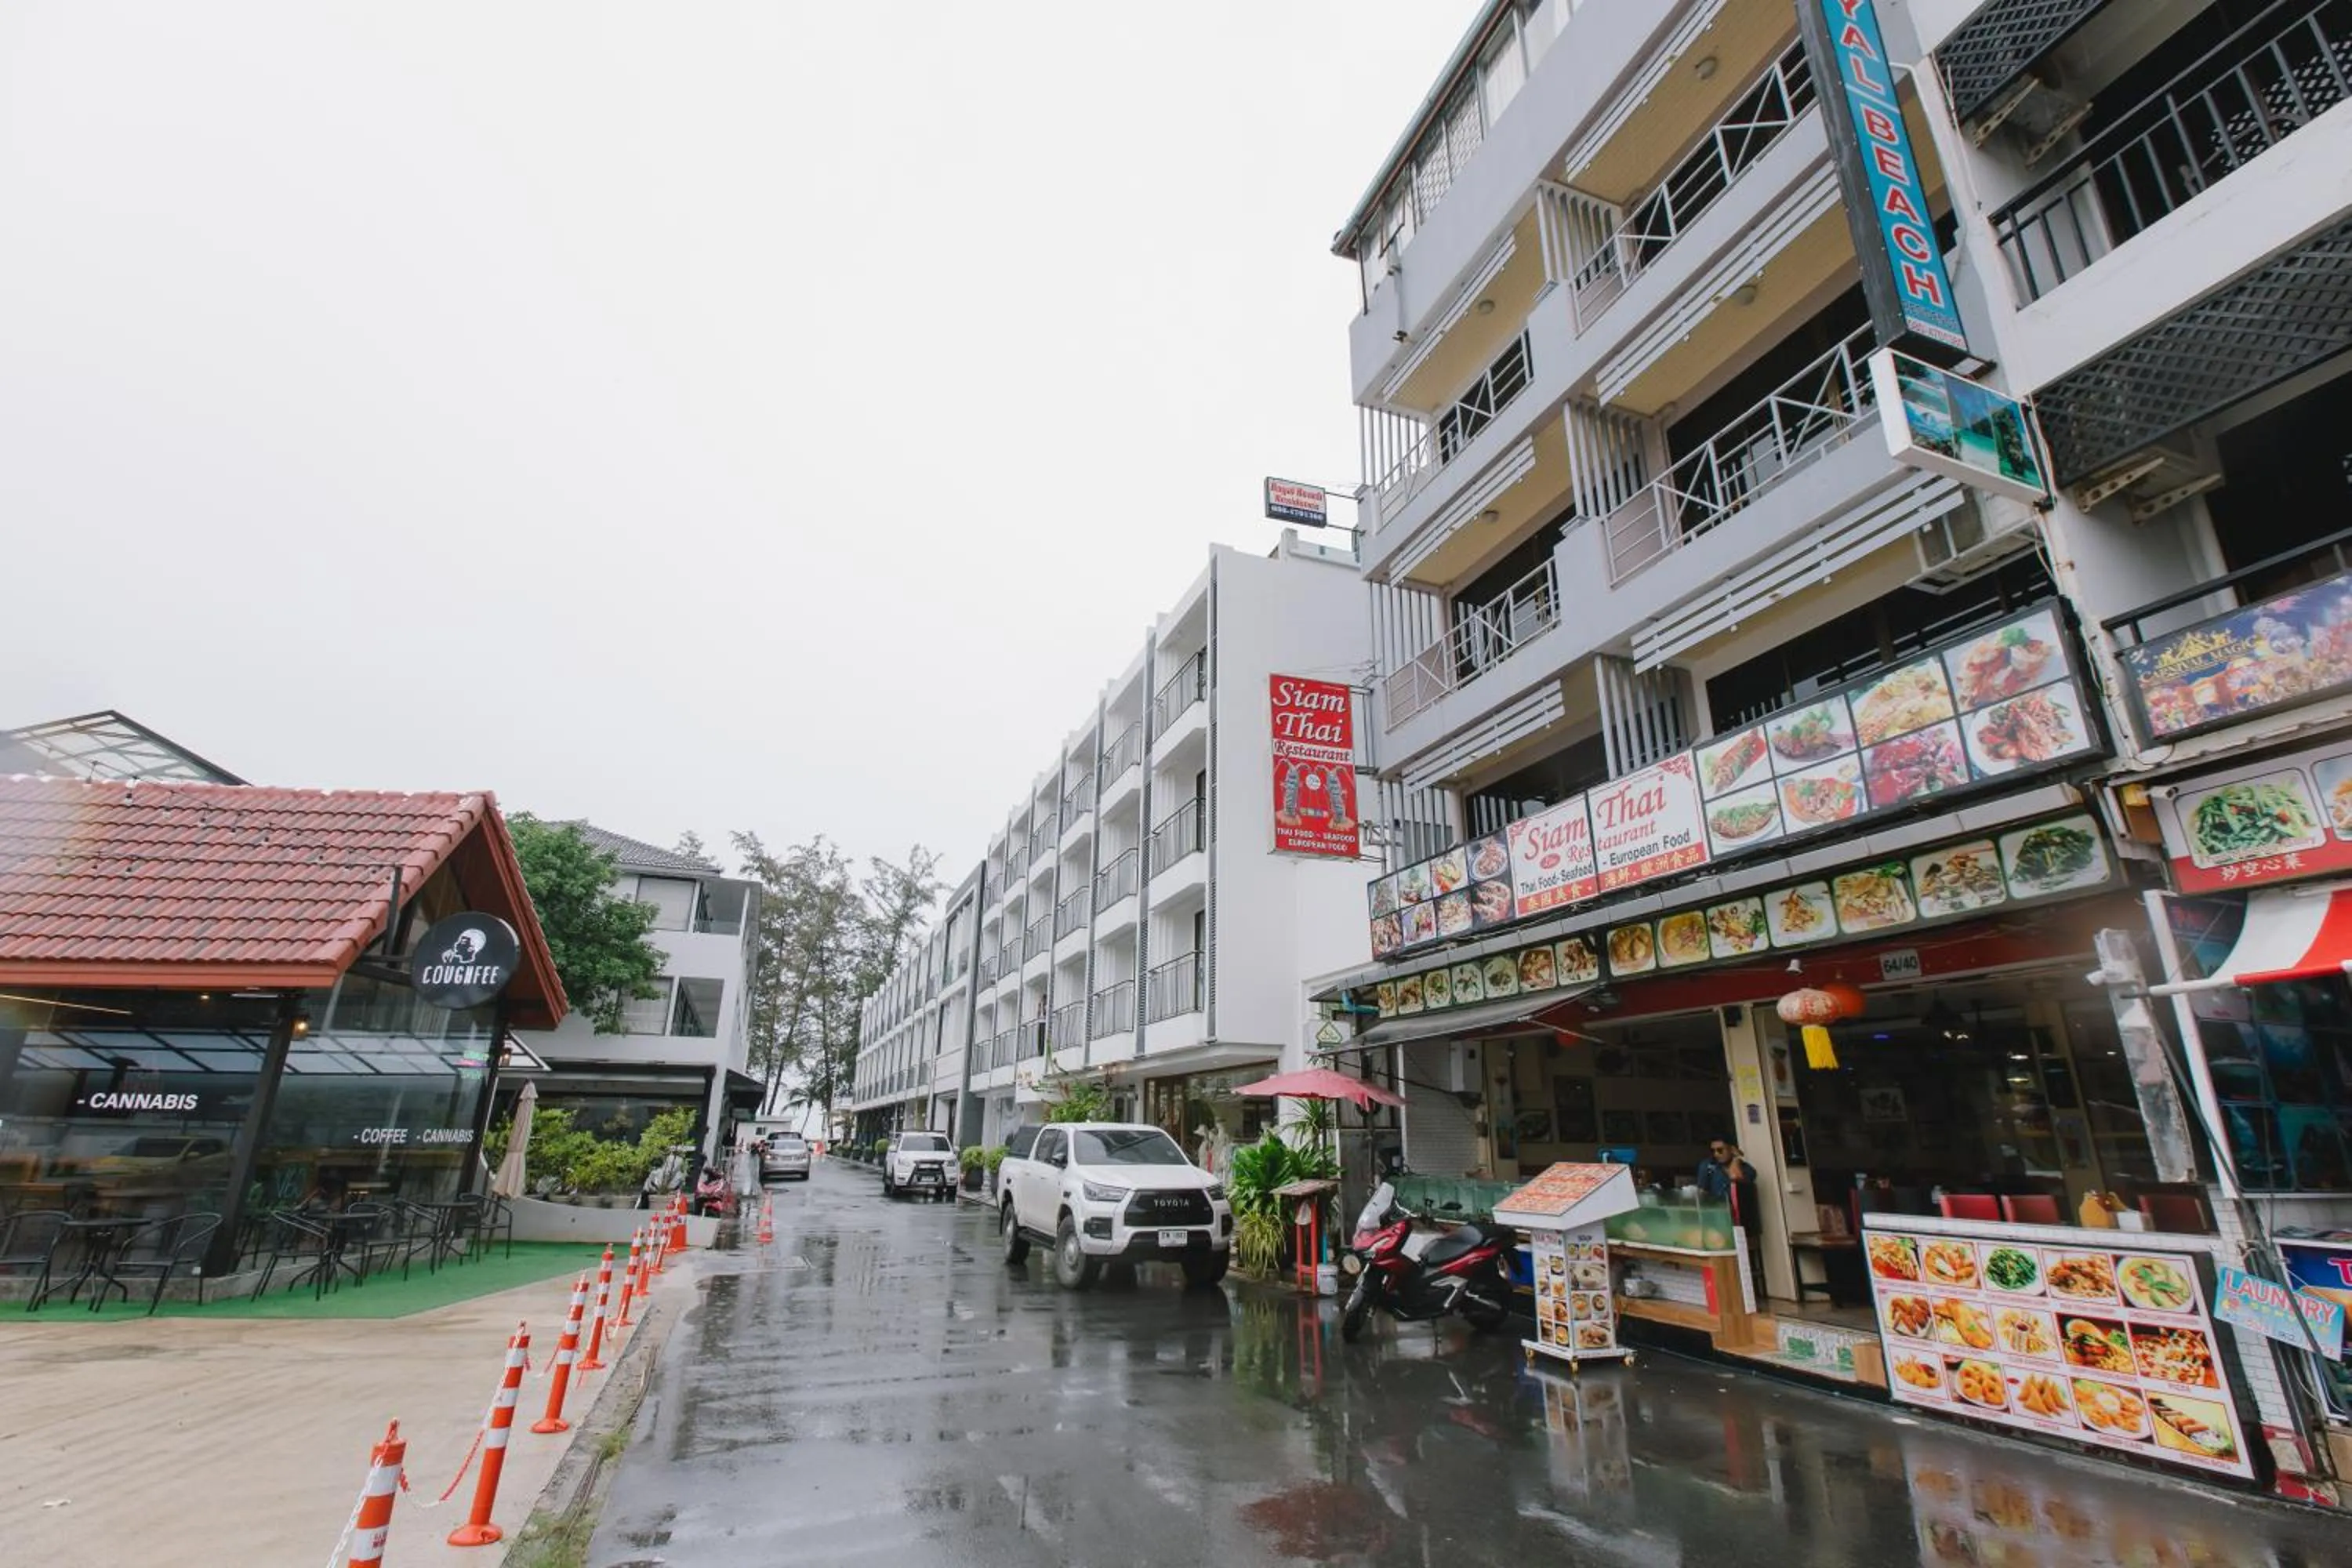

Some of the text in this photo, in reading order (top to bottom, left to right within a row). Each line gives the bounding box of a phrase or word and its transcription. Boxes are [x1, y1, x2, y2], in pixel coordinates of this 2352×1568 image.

[1860, 103, 1944, 309] BEACH
[1273, 682, 1346, 713] Siam
[1276, 712, 1343, 742] Thai
[1275, 741, 1350, 760] Restaurant
[1524, 775, 1666, 859] Siam Thai
[1519, 879, 1536, 895] Thai
[1609, 841, 1660, 866] European
[1662, 827, 1690, 848] Food
[1883, 956, 1918, 974] 64/40
[89, 1092, 198, 1110] CANNABIS
[361, 1128, 474, 1143] COFFEE CANNABIS
[1153, 1197, 1190, 1208] TOYOTA
